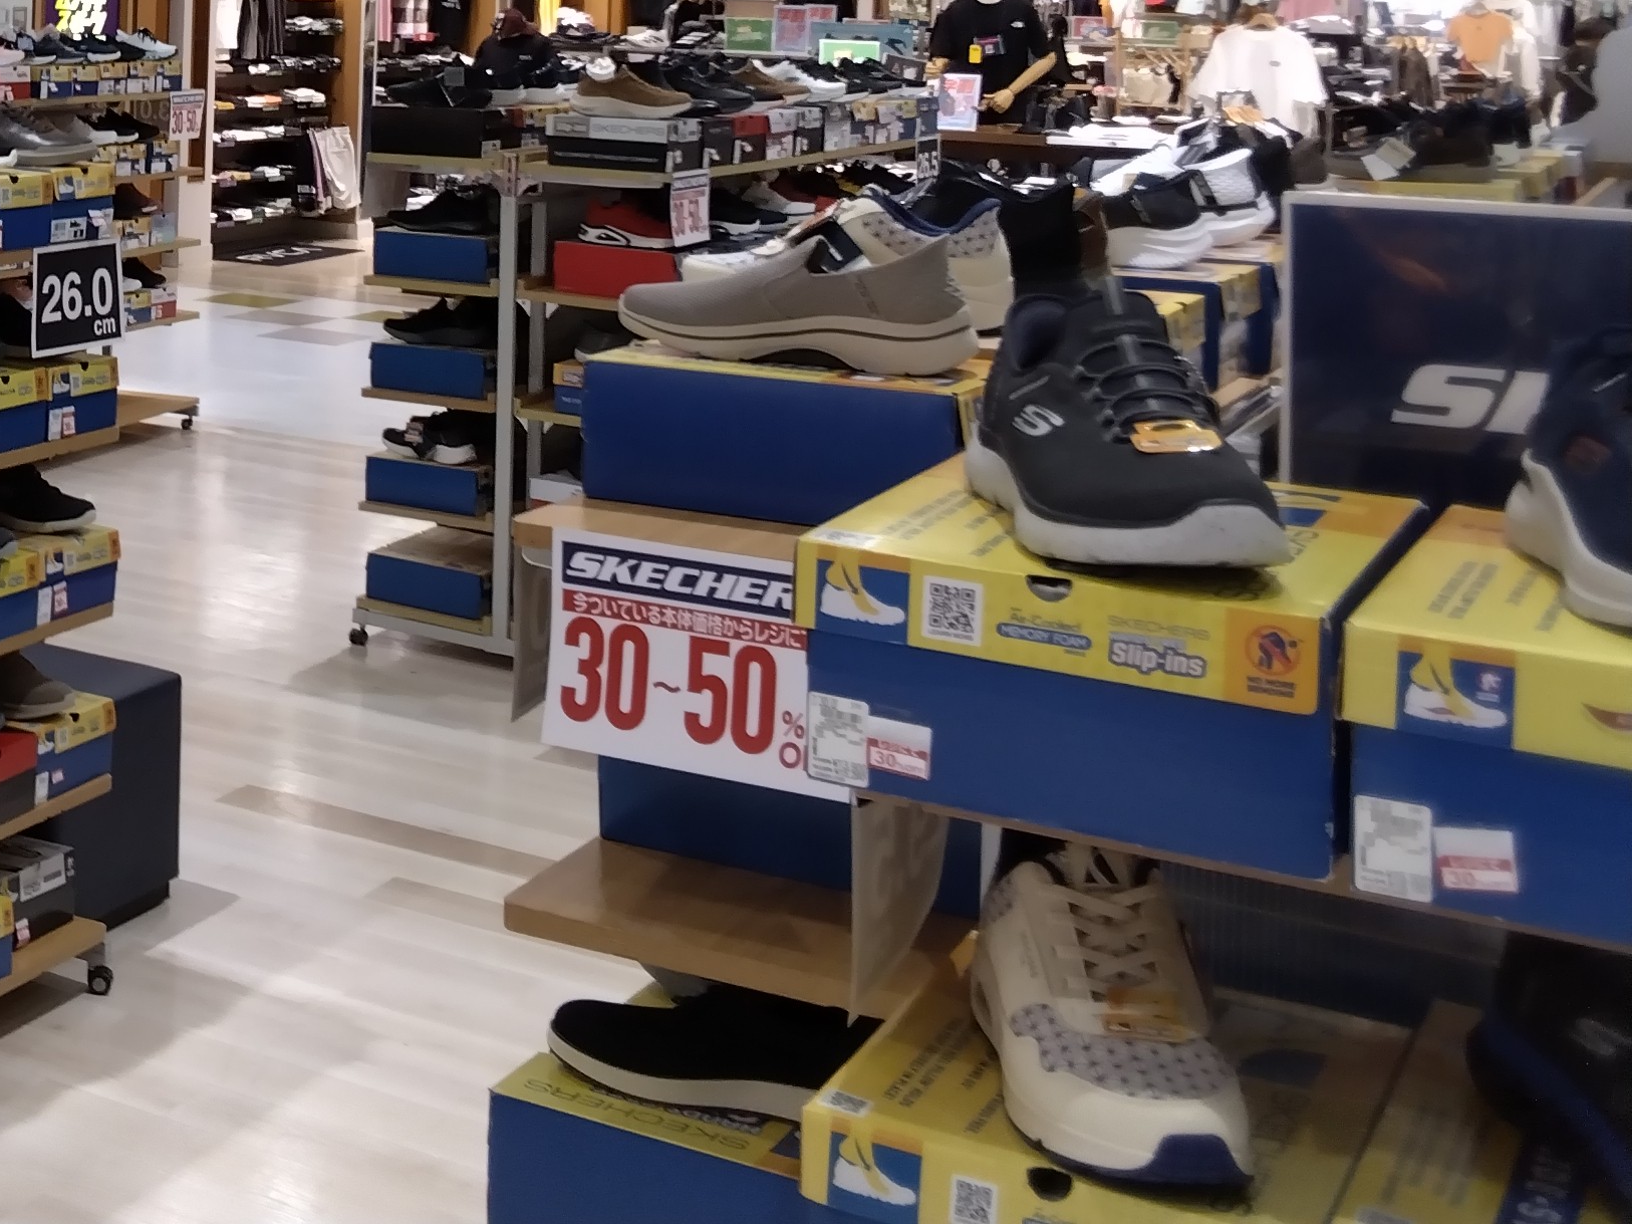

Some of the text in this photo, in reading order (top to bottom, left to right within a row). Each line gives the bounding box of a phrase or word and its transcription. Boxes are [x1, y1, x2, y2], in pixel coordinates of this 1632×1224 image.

[41, 267, 114, 323] 26.0
[93, 317, 116, 336] cm
[566, 551, 793, 610] SKECHER
[573, 593, 806, 649] 今ついている本体価格からレジに
[1110, 640, 1206, 677] Slip-ins
[523, 1078, 751, 1151] SKECHERS
